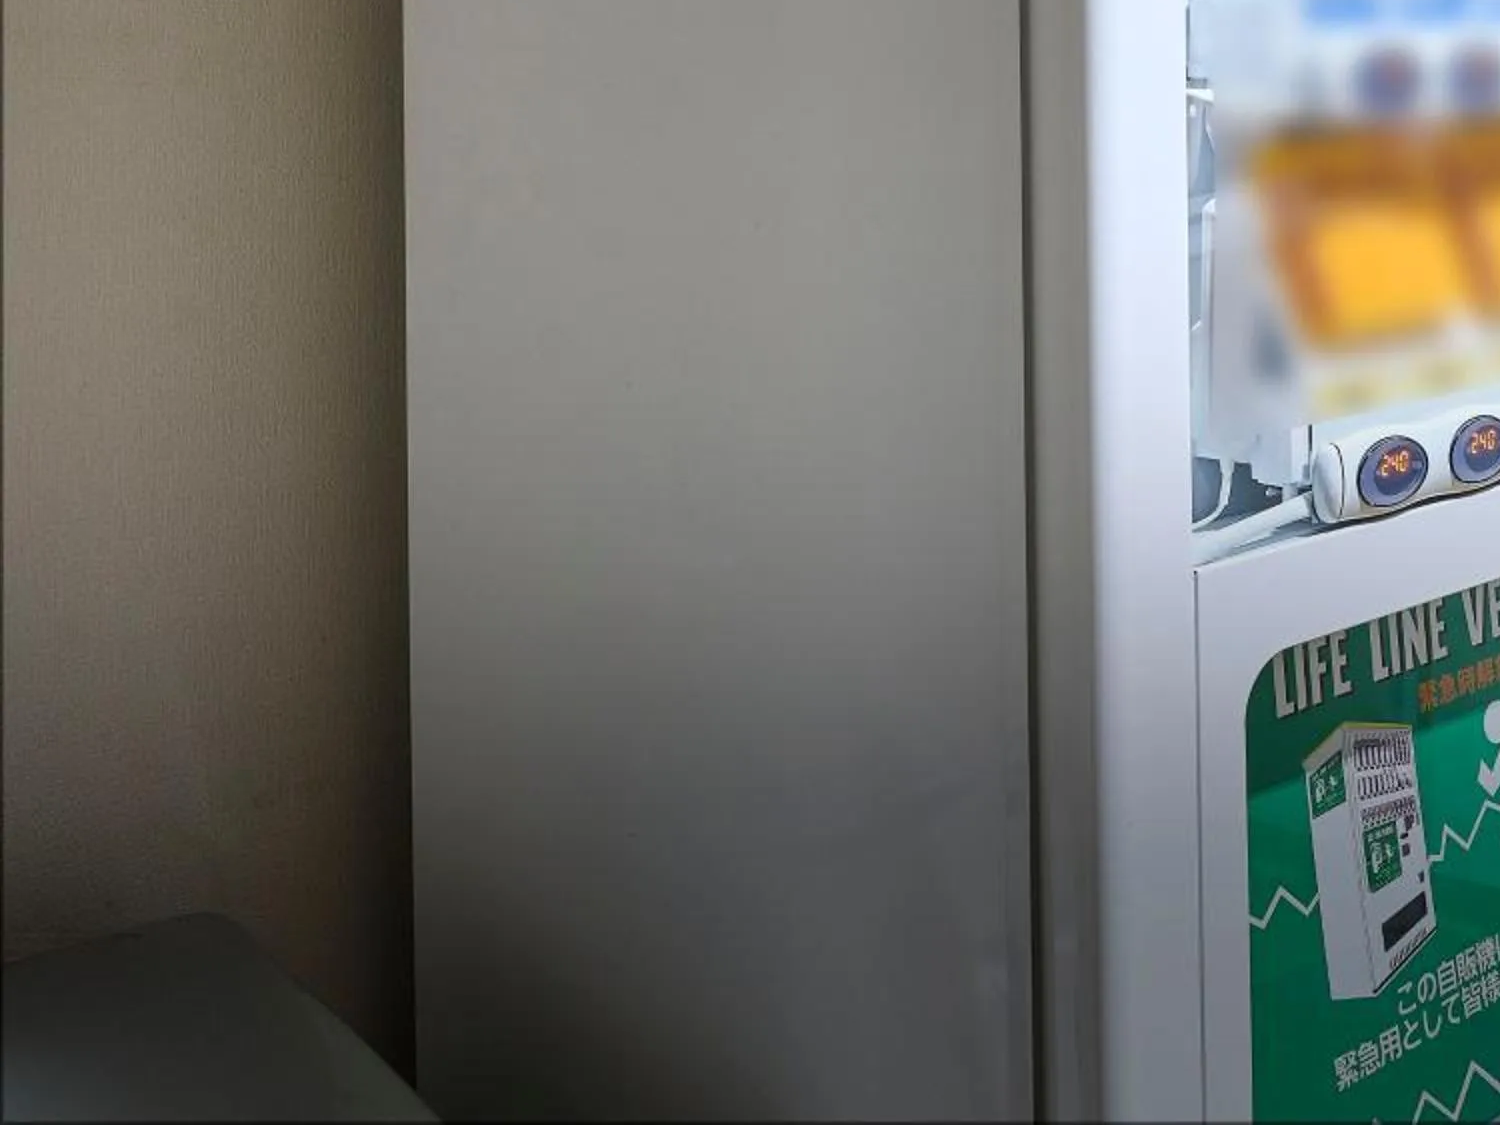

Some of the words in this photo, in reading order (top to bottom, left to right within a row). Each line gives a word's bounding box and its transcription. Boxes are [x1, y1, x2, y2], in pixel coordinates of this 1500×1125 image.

[1469, 429, 1497, 455] 240
[1380, 450, 1409, 477] 240
[1273, 629, 1352, 719] LIFE
[1369, 598, 1449, 683] LINE
